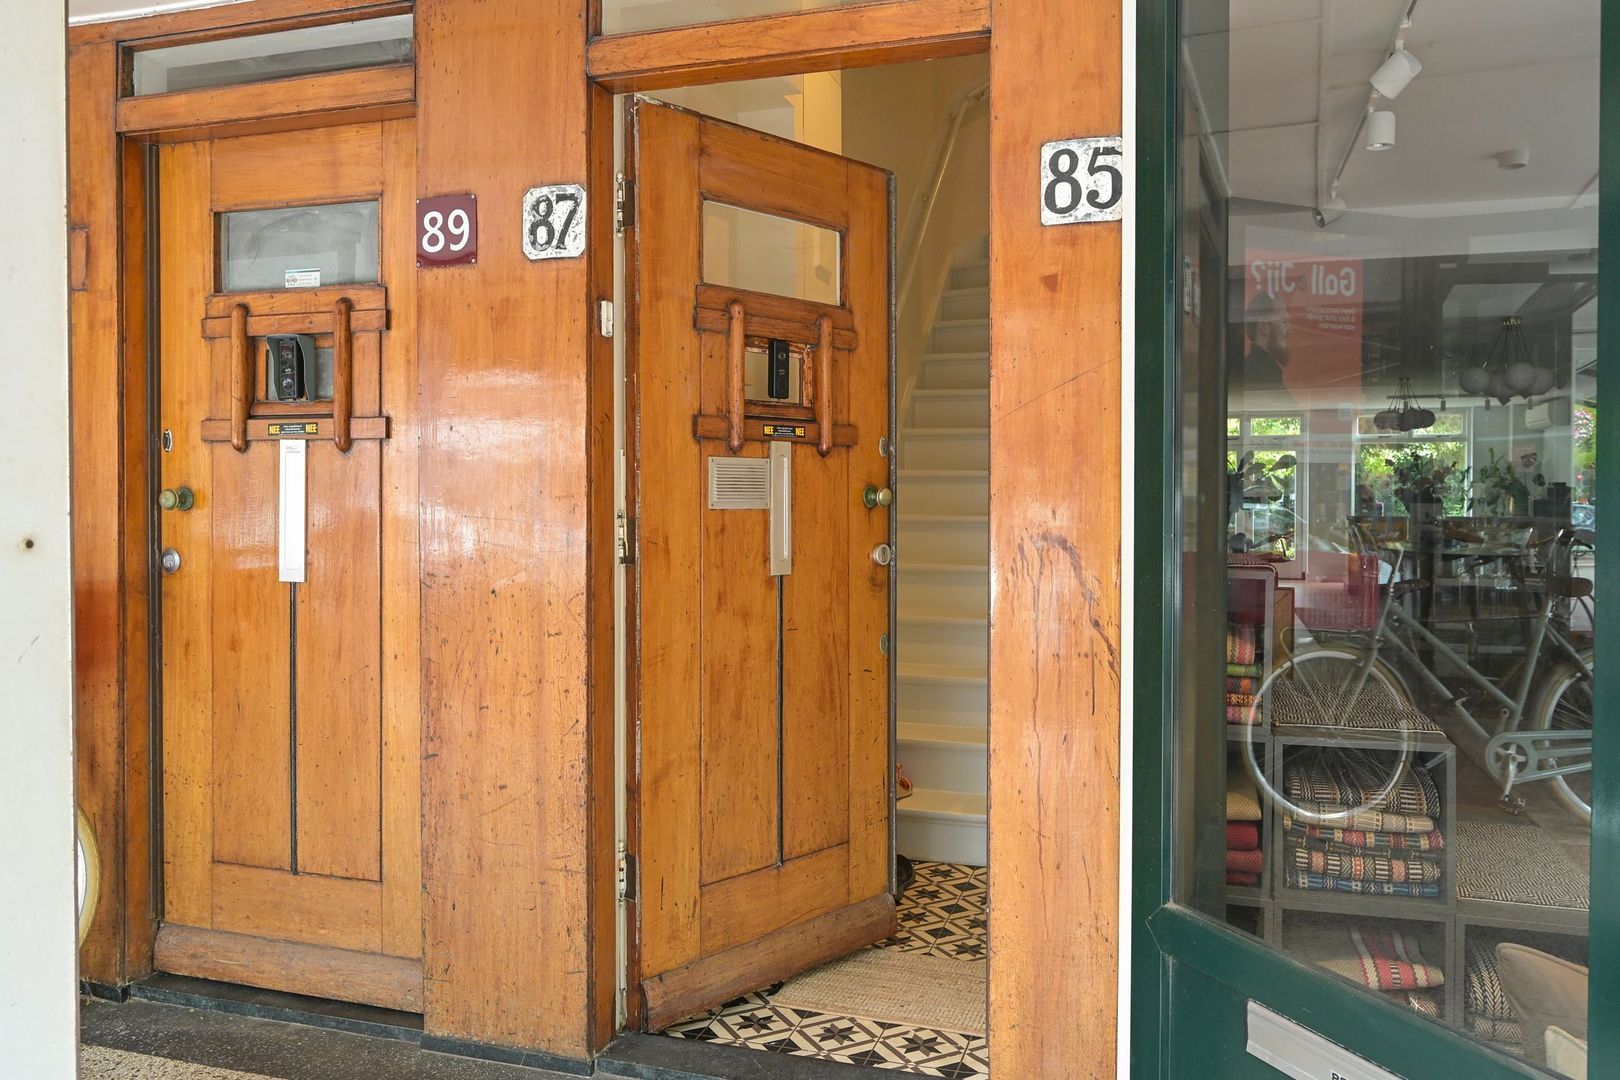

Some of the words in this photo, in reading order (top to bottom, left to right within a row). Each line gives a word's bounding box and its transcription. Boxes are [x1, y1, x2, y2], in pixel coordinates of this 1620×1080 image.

[1044, 147, 1122, 214] 85
[529, 193, 582, 251] 87
[421, 208, 470, 253] 89
[269, 425, 280, 434] NEE
[305, 423, 317, 433] NEE
[764, 426, 774, 435] NEE
[795, 427, 805, 436] NEE
